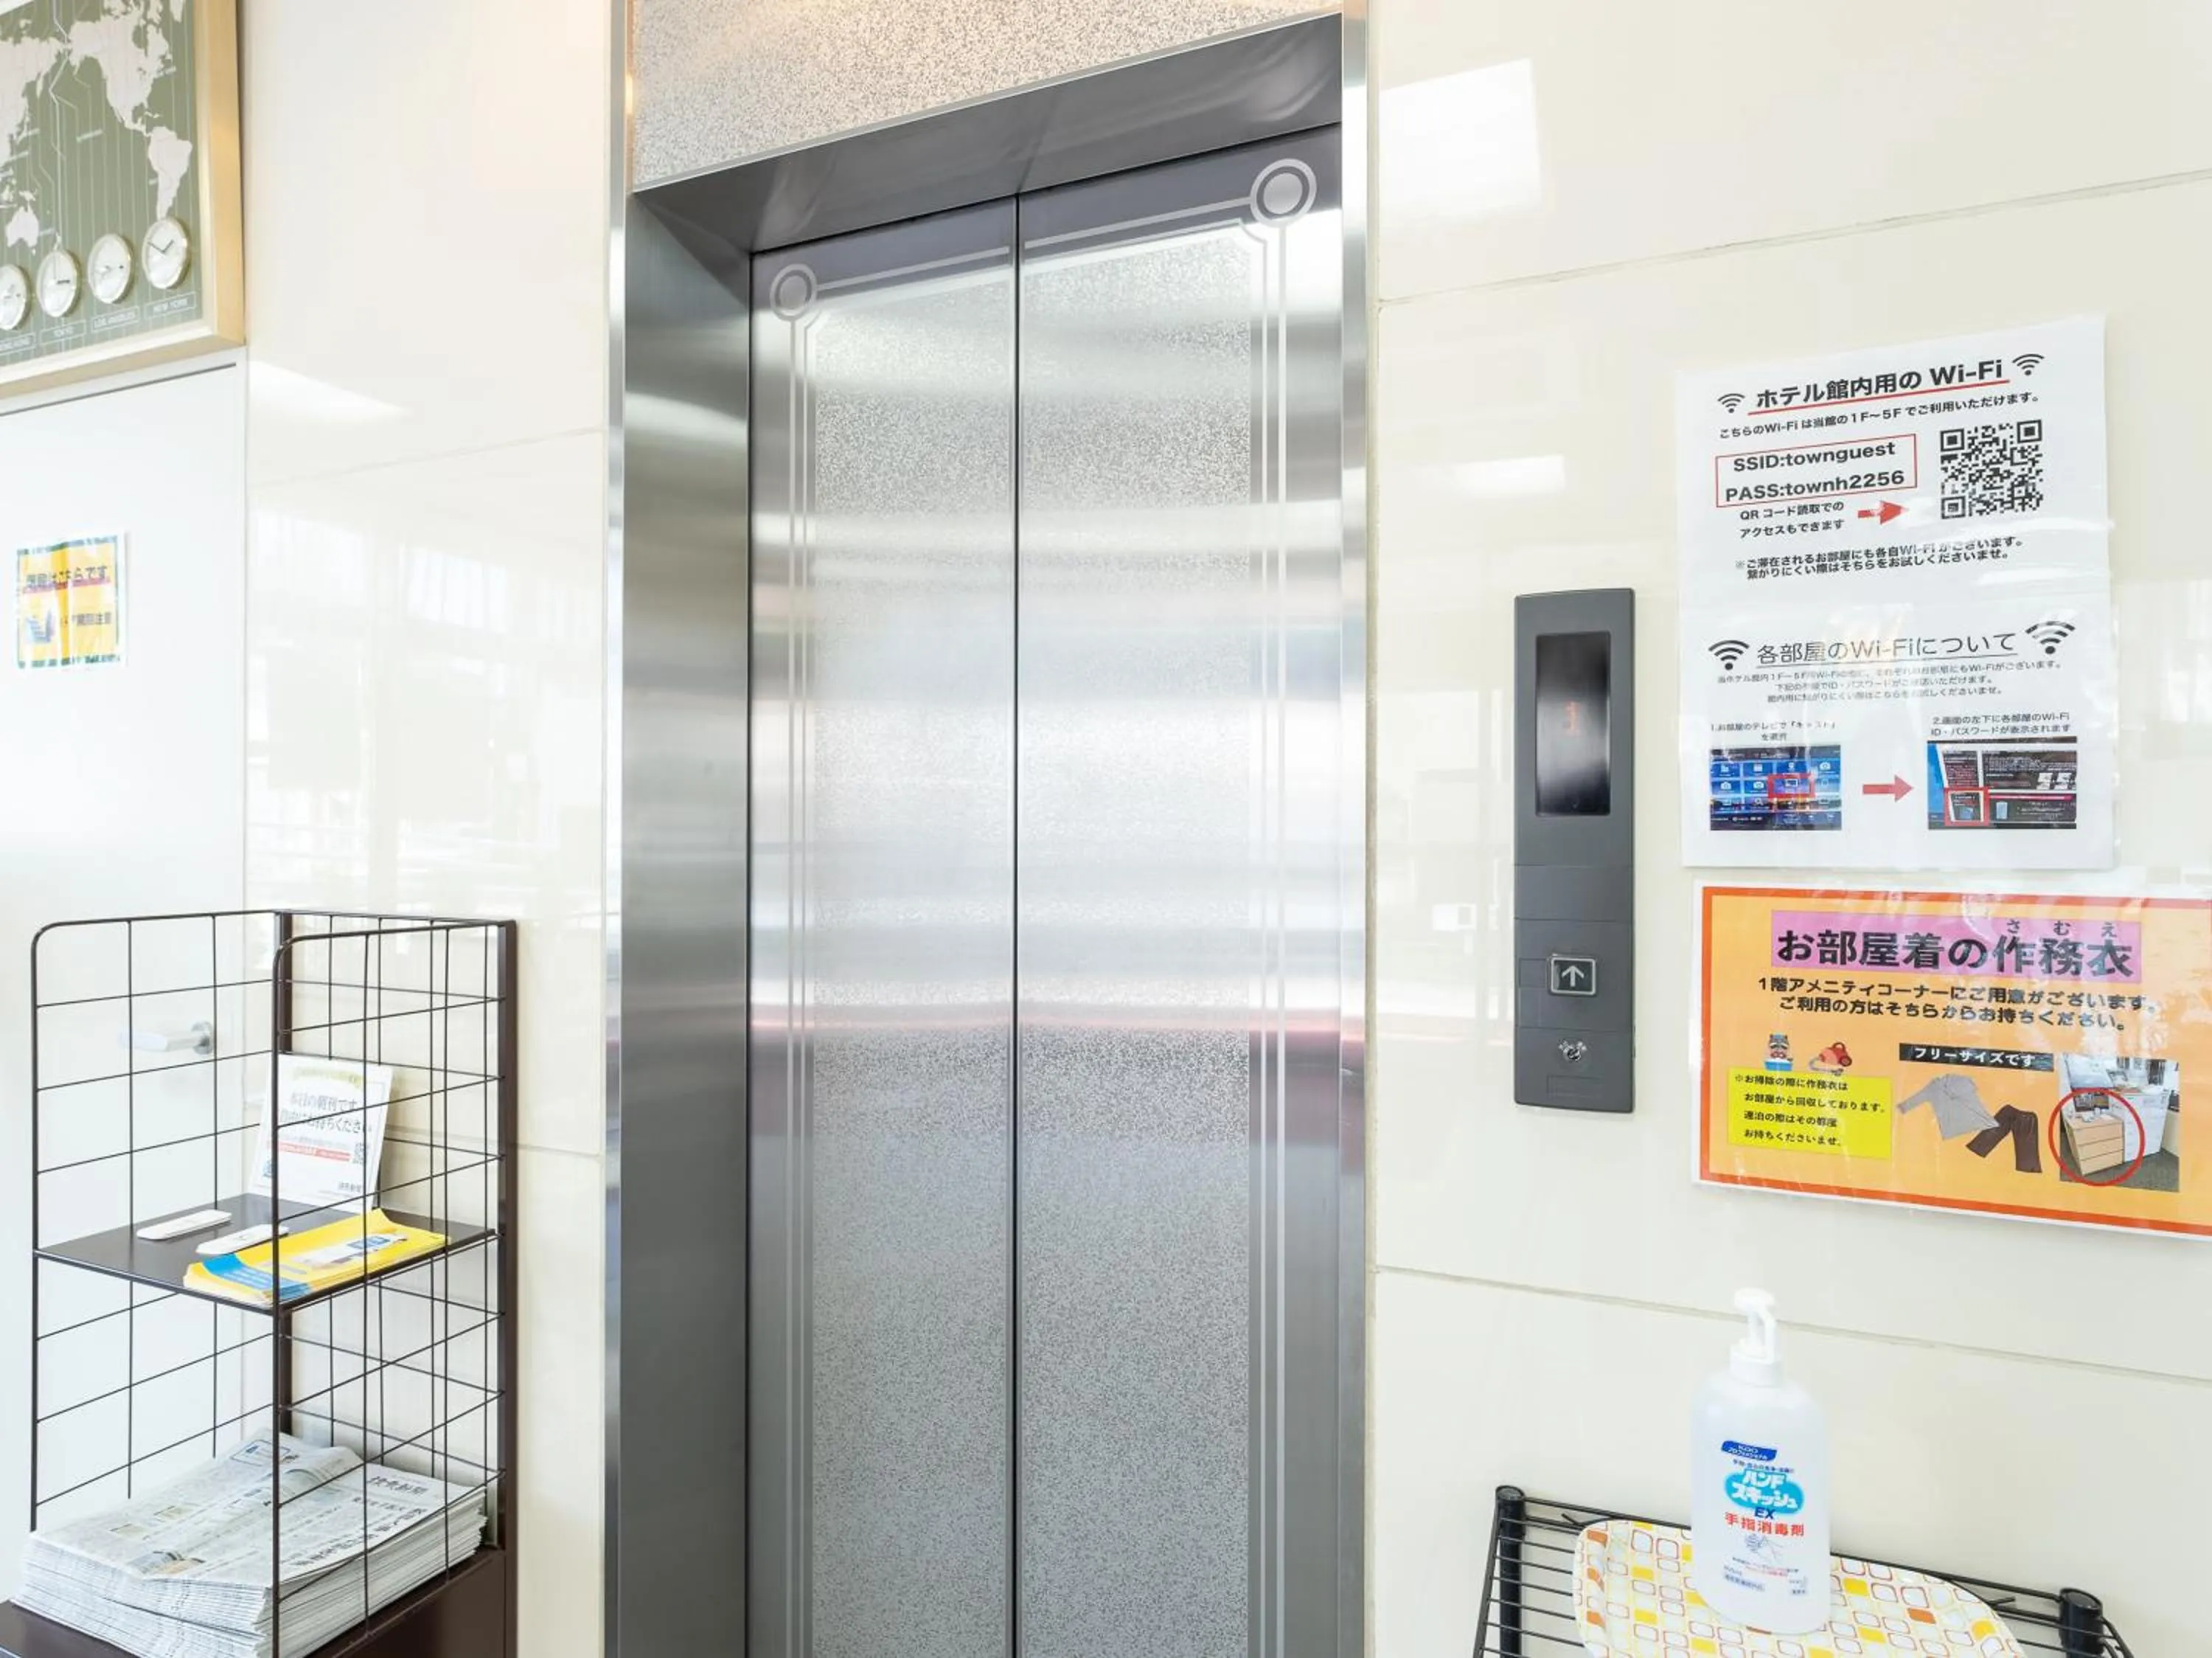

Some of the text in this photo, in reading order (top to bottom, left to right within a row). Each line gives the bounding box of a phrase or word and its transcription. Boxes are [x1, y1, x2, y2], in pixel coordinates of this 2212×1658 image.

[1757, 360, 2002, 408] ホテル館内用の Wi-Fi
[1733, 443, 1896, 472] SSID:townguest
[1726, 470, 1905, 502] PASS:townh2256
[1740, 502, 1845, 521] QR コード読取での
[1740, 519, 1846, 539] アクセスもできます
[1757, 633, 2016, 665] 各部屋のWi-Fiについて
[1778, 929, 2133, 977] お部屋着の作務衣
[1759, 977, 2156, 1013] 1階アメニティコーナーにご用意がございます。
[1780, 996, 2124, 1031] ご利用の方はそちらからお持ちください。
[1915, 1047, 2036, 1067] フリーサイズです
[1745, 1093, 1885, 1113] お部屋から回収しております。
[1745, 1129, 1841, 1146] お持ちくださいませ。
[1742, 1470, 1786, 1489] ハンド
[1731, 1482, 1798, 1509] スキッシュ
[1725, 1511, 1804, 1536] 手指消毒剤
[1755, 1507, 1775, 1519] EX
